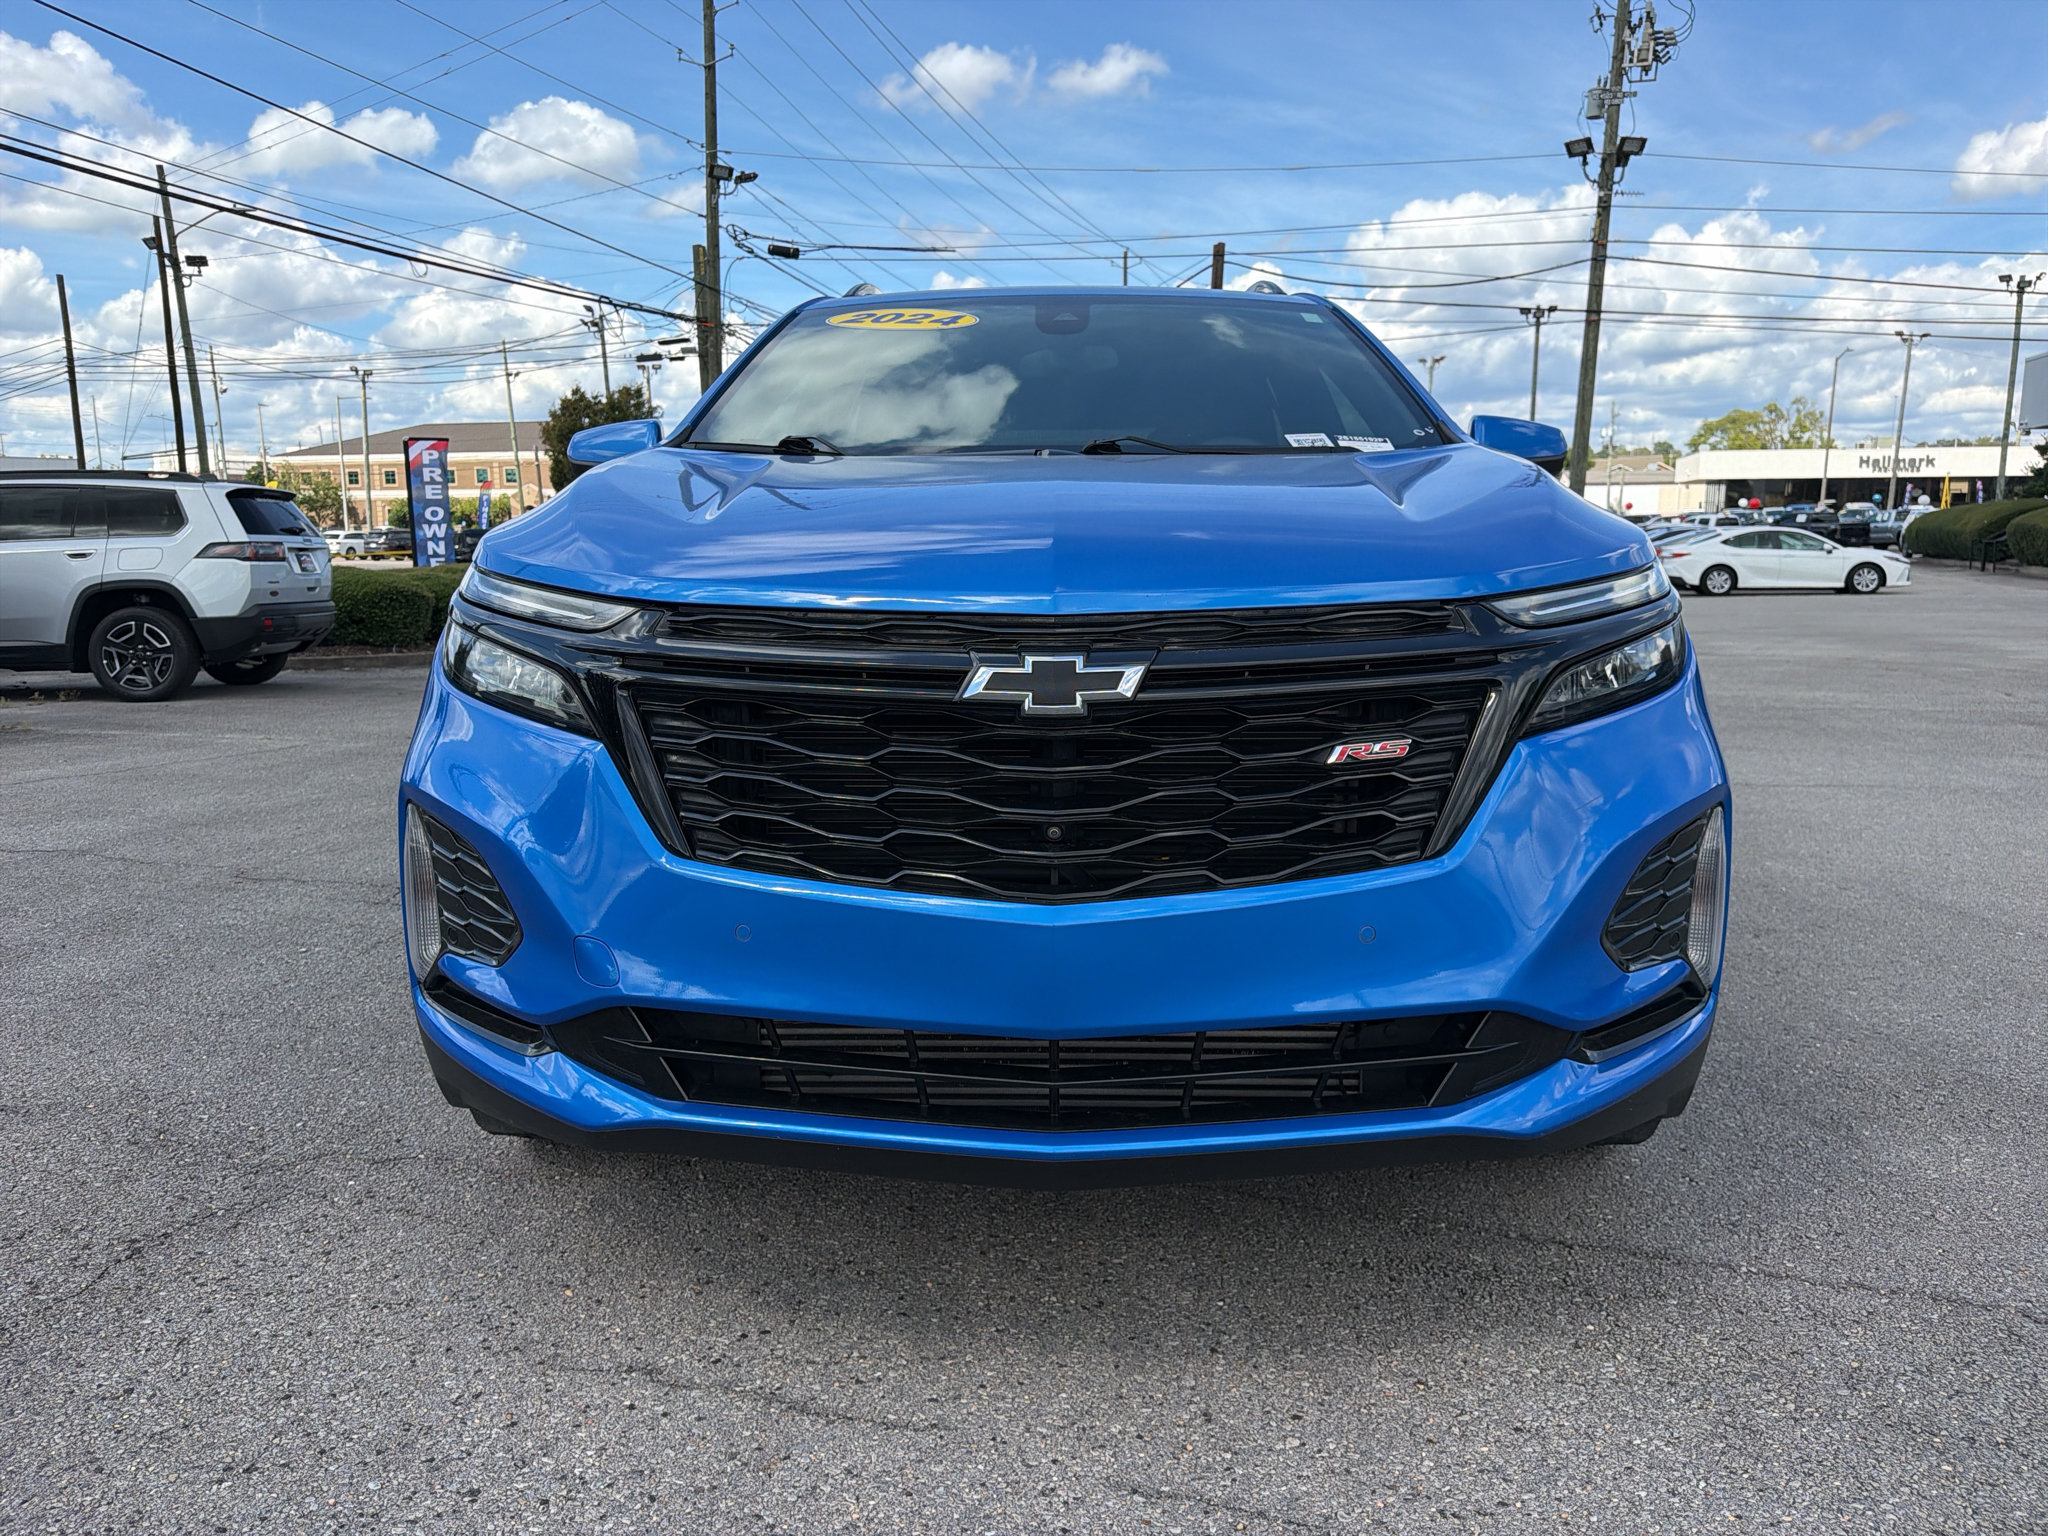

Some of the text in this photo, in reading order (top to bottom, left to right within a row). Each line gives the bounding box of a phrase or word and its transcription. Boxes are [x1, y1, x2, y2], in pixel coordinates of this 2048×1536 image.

[838, 312, 967, 326] 2024
[1859, 454, 1936, 469] Hallmark
[422, 449, 443, 500] PRE
[1326, 739, 1412, 764] RS
